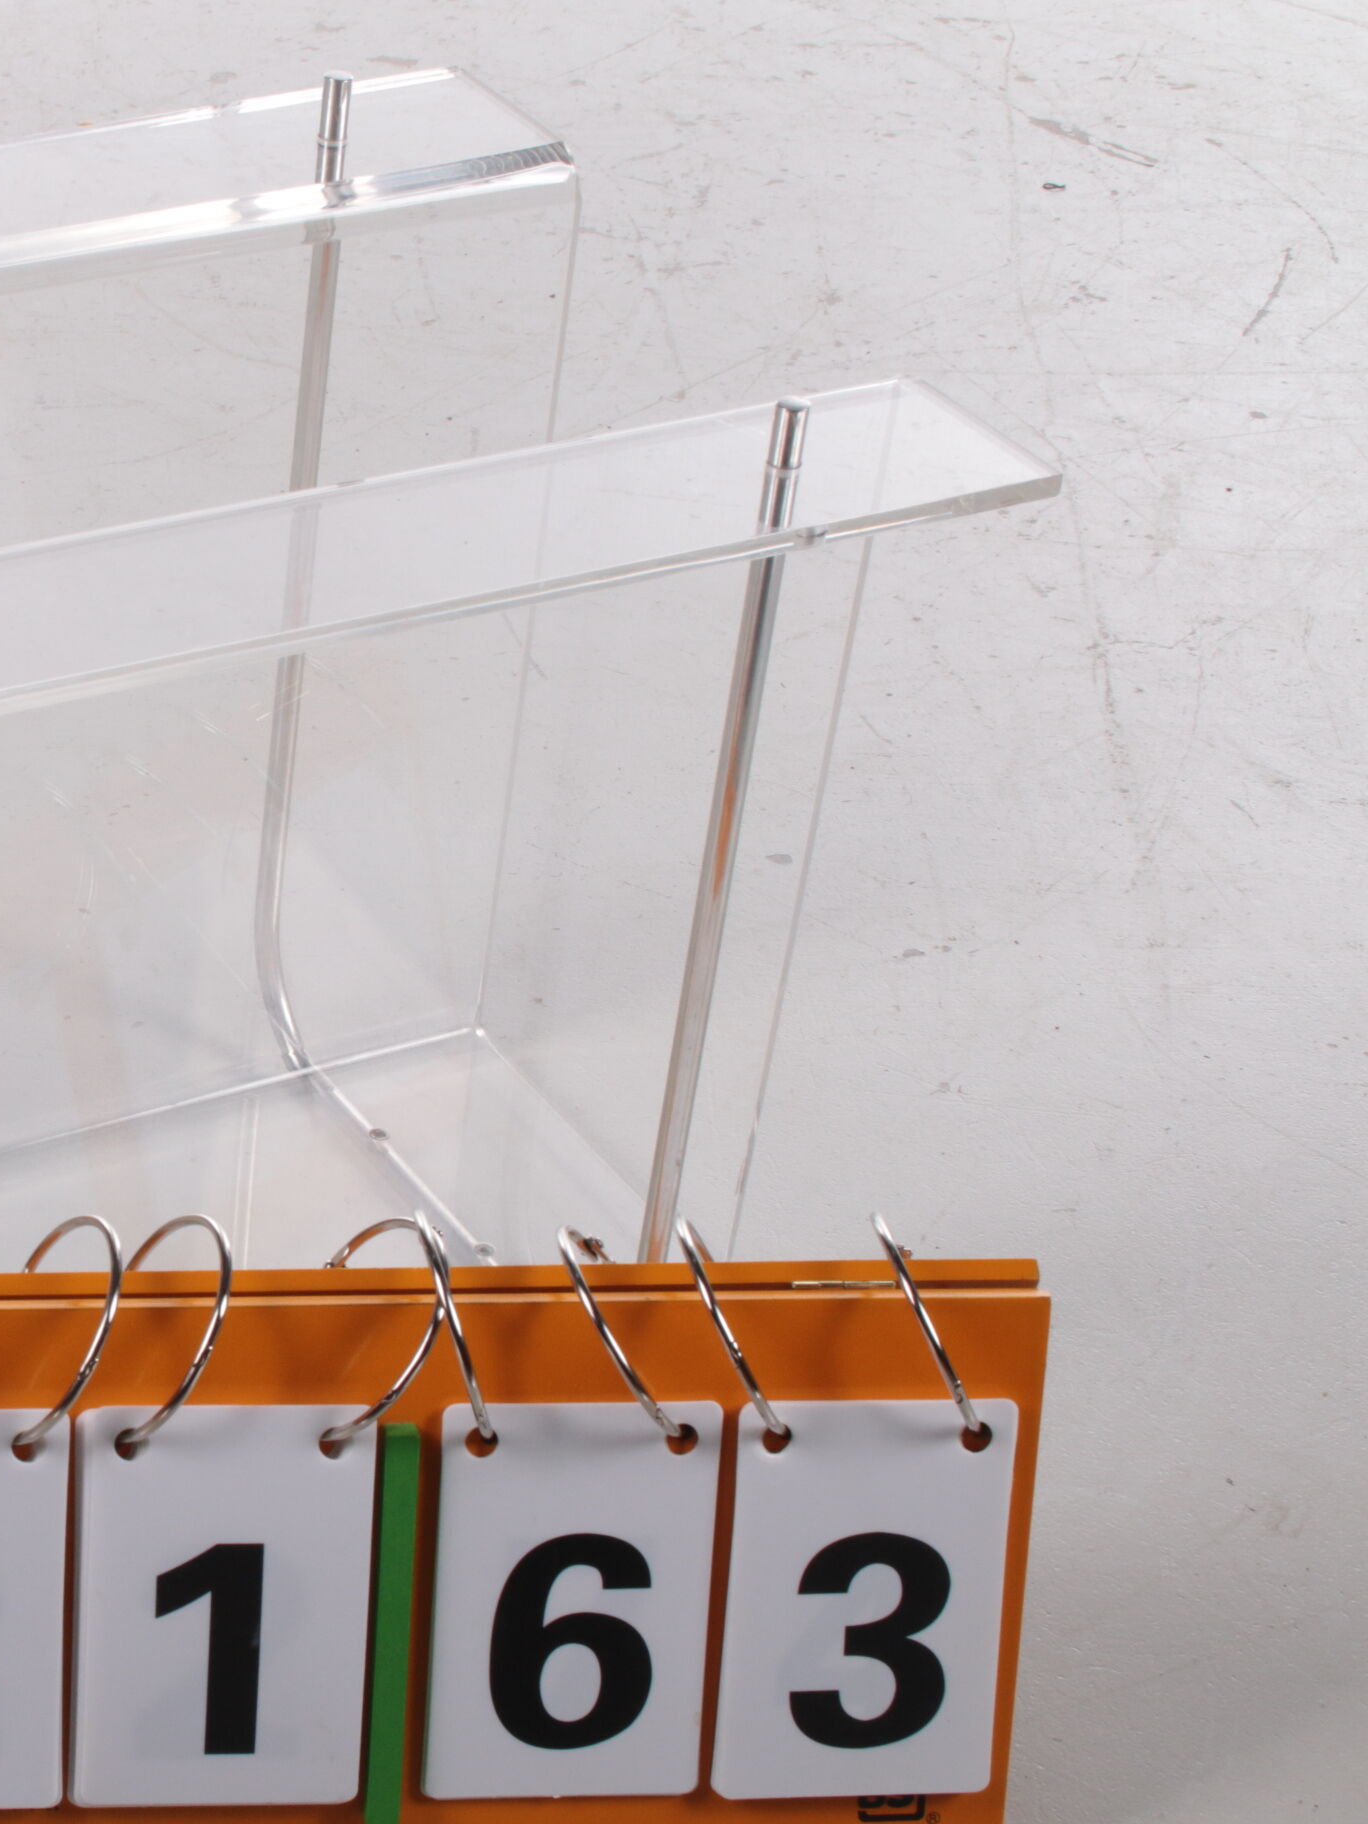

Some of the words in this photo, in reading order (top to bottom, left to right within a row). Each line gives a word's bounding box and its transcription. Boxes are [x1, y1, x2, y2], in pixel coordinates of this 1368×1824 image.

[155, 1543, 265, 1755] 1
[489, 1533, 652, 1750] 6
[789, 1532, 951, 1749] 3
